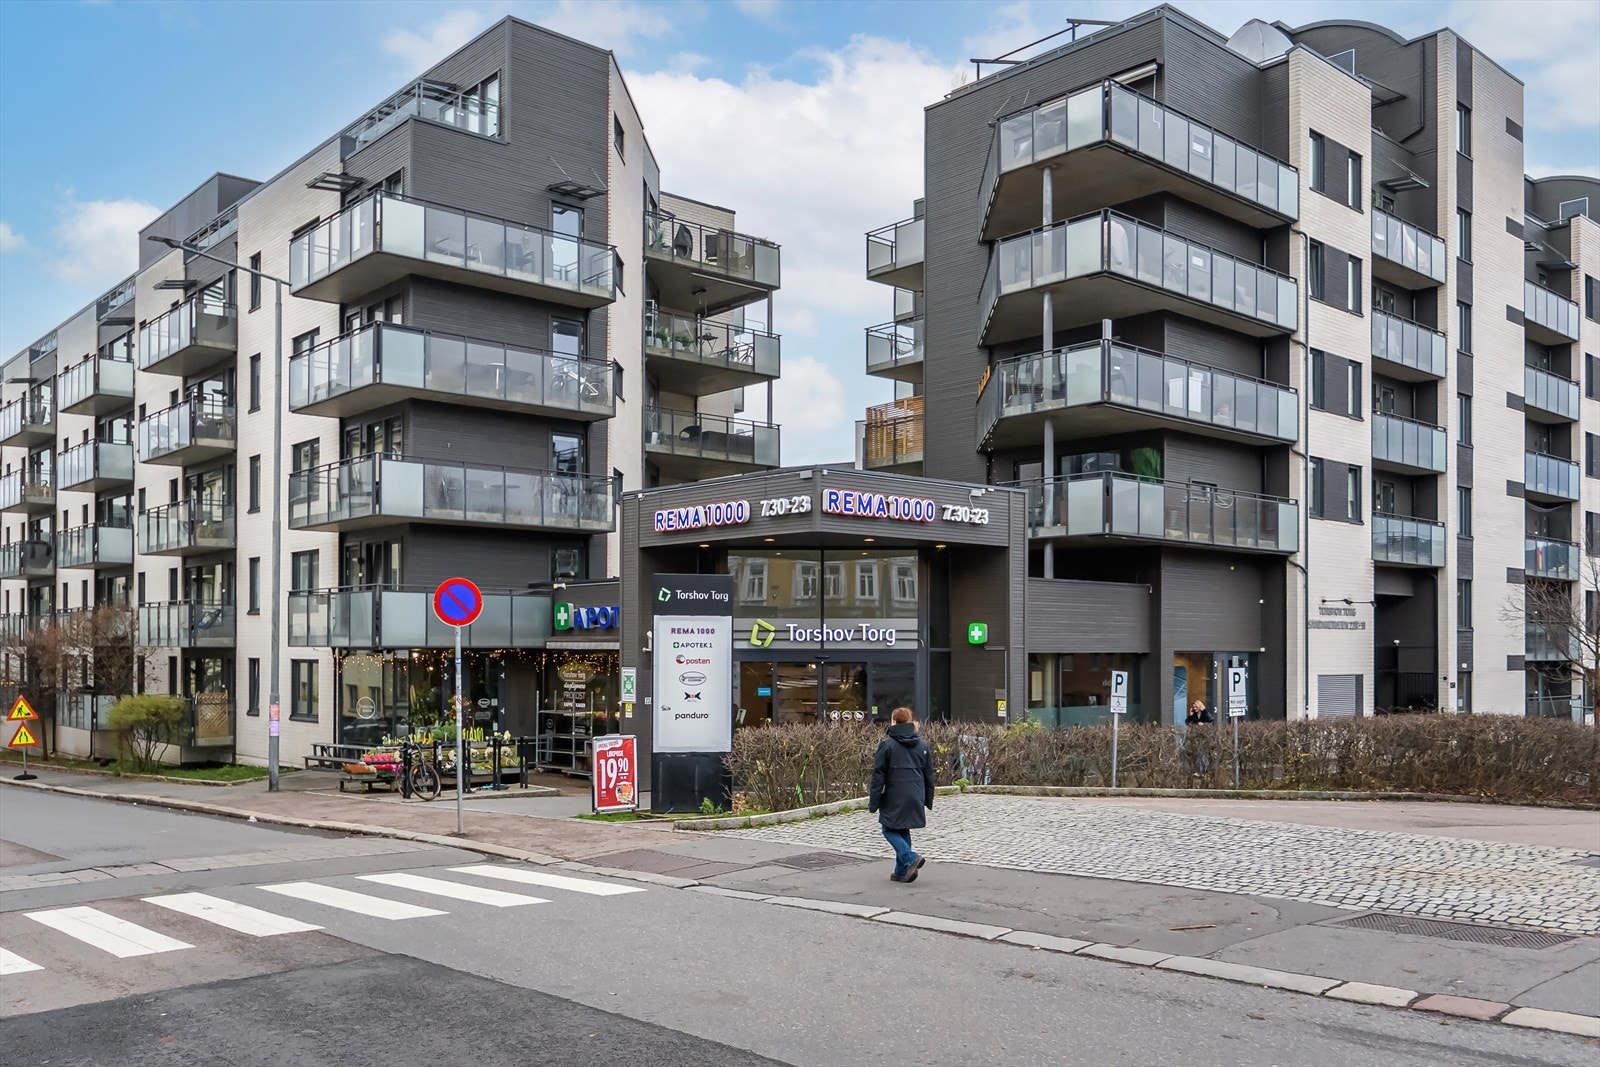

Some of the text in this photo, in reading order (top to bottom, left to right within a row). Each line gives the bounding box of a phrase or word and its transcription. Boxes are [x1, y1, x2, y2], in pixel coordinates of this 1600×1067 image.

[654, 500, 749, 531] REMA 1000
[824, 489, 936, 522] REMA 1000
[676, 589, 729, 602] Torshov Torg
[785, 623, 896, 646] Torshov Torg
[1114, 673, 1124, 693] P
[1233, 672, 1241, 692] P
[675, 712, 709, 720] panduro
